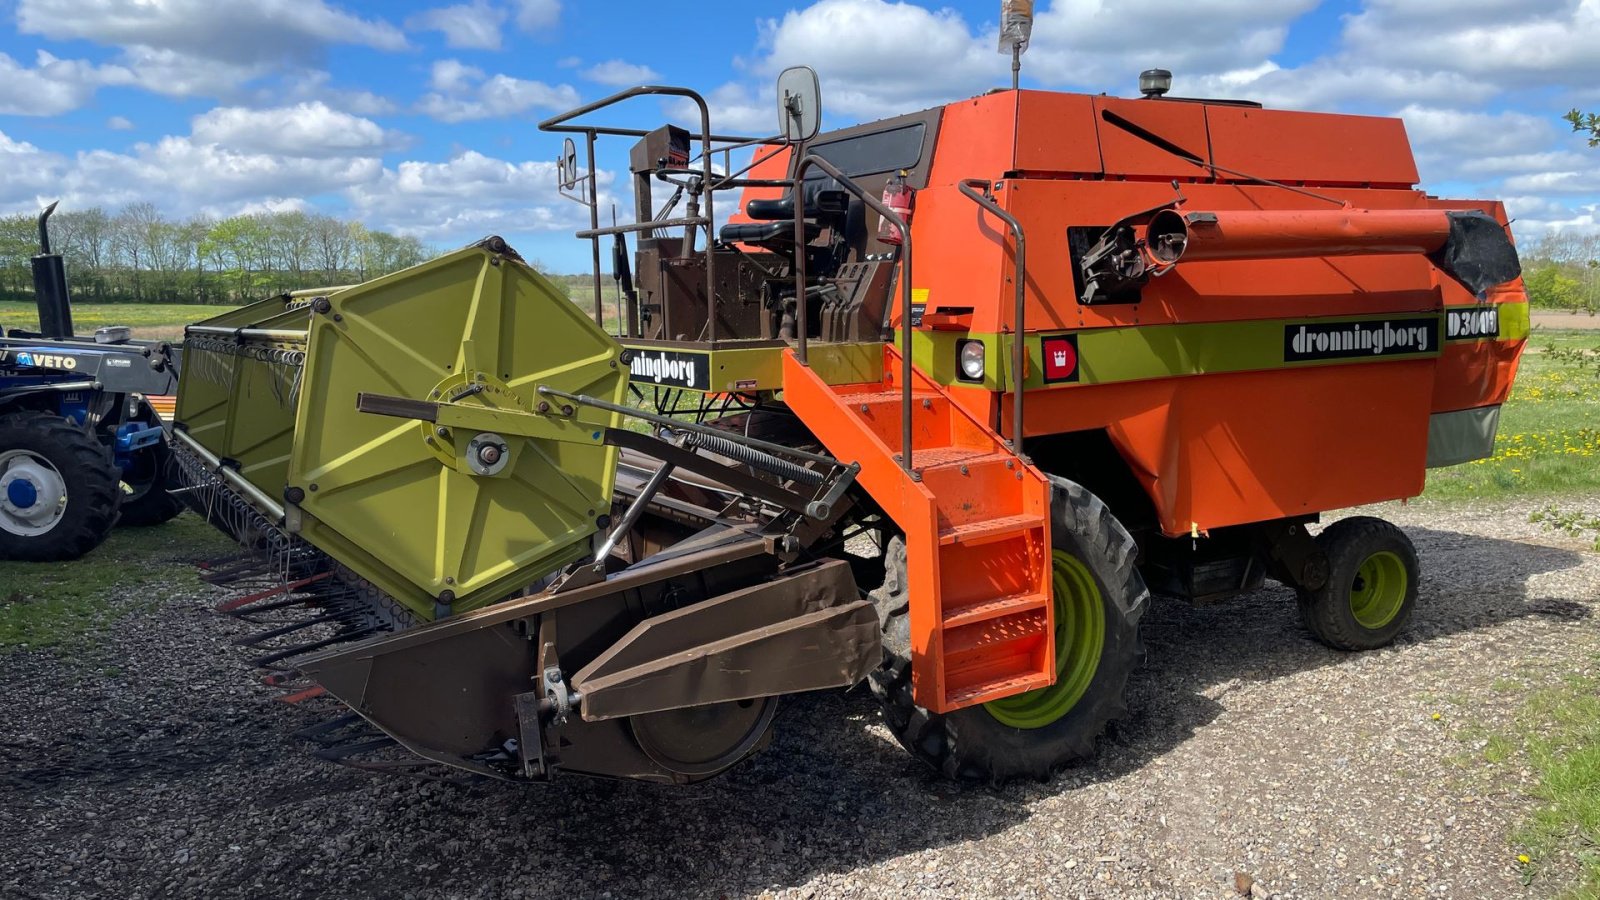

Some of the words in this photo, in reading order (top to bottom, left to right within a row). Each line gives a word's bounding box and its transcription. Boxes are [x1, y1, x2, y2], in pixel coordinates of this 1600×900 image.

[1292, 322, 1428, 354] dronningborg
[33, 354, 77, 369] VETO
[630, 351, 695, 387] ningborg
